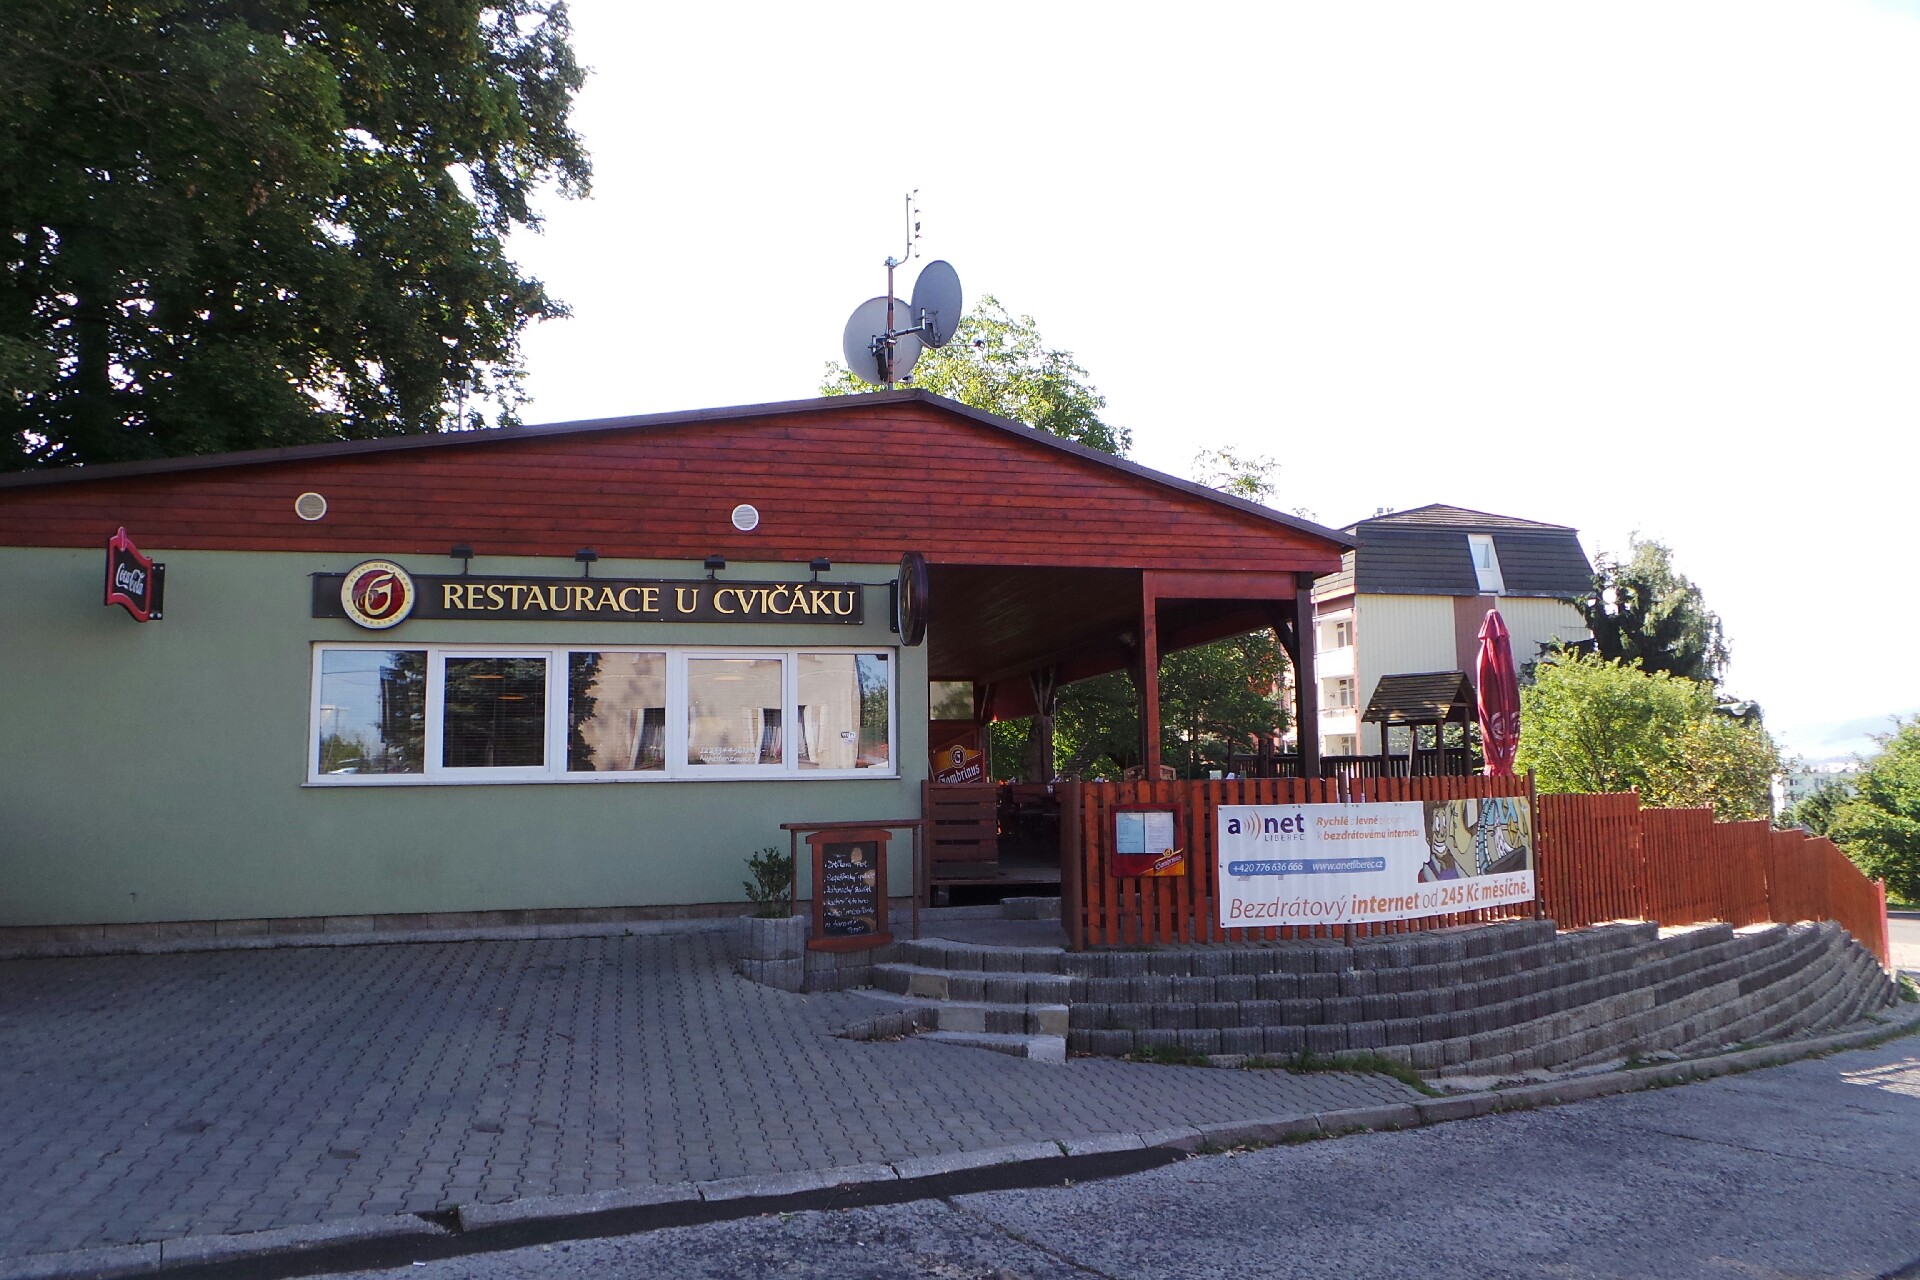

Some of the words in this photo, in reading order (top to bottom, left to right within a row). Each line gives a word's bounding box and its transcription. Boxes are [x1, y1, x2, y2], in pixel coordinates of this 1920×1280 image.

[441, 584, 660, 612] RESTAURACE
[675, 587, 699, 613] U
[713, 584, 856, 615] CVIČÁKU
[1316, 816, 1348, 828] Rychlé
[1355, 815, 1378, 825] levné
[1323, 830, 1386, 840] bezdrátovému
[1387, 828, 1419, 838] internetu
[1233, 864, 1255, 873] +420
[1256, 863, 1271, 872] 776
[1271, 862, 1287, 872] 636
[1287, 862, 1304, 871] 666
[1312, 860, 1383, 870] www.anetliberec.cz
[1229, 895, 1348, 921] Bezdrátový
[1351, 892, 1419, 915] internet
[1422, 887, 1439, 909] od
[1441, 885, 1464, 906] 245
[1466, 882, 1480, 902] Kč
[1481, 875, 1530, 899] měsíčně.
